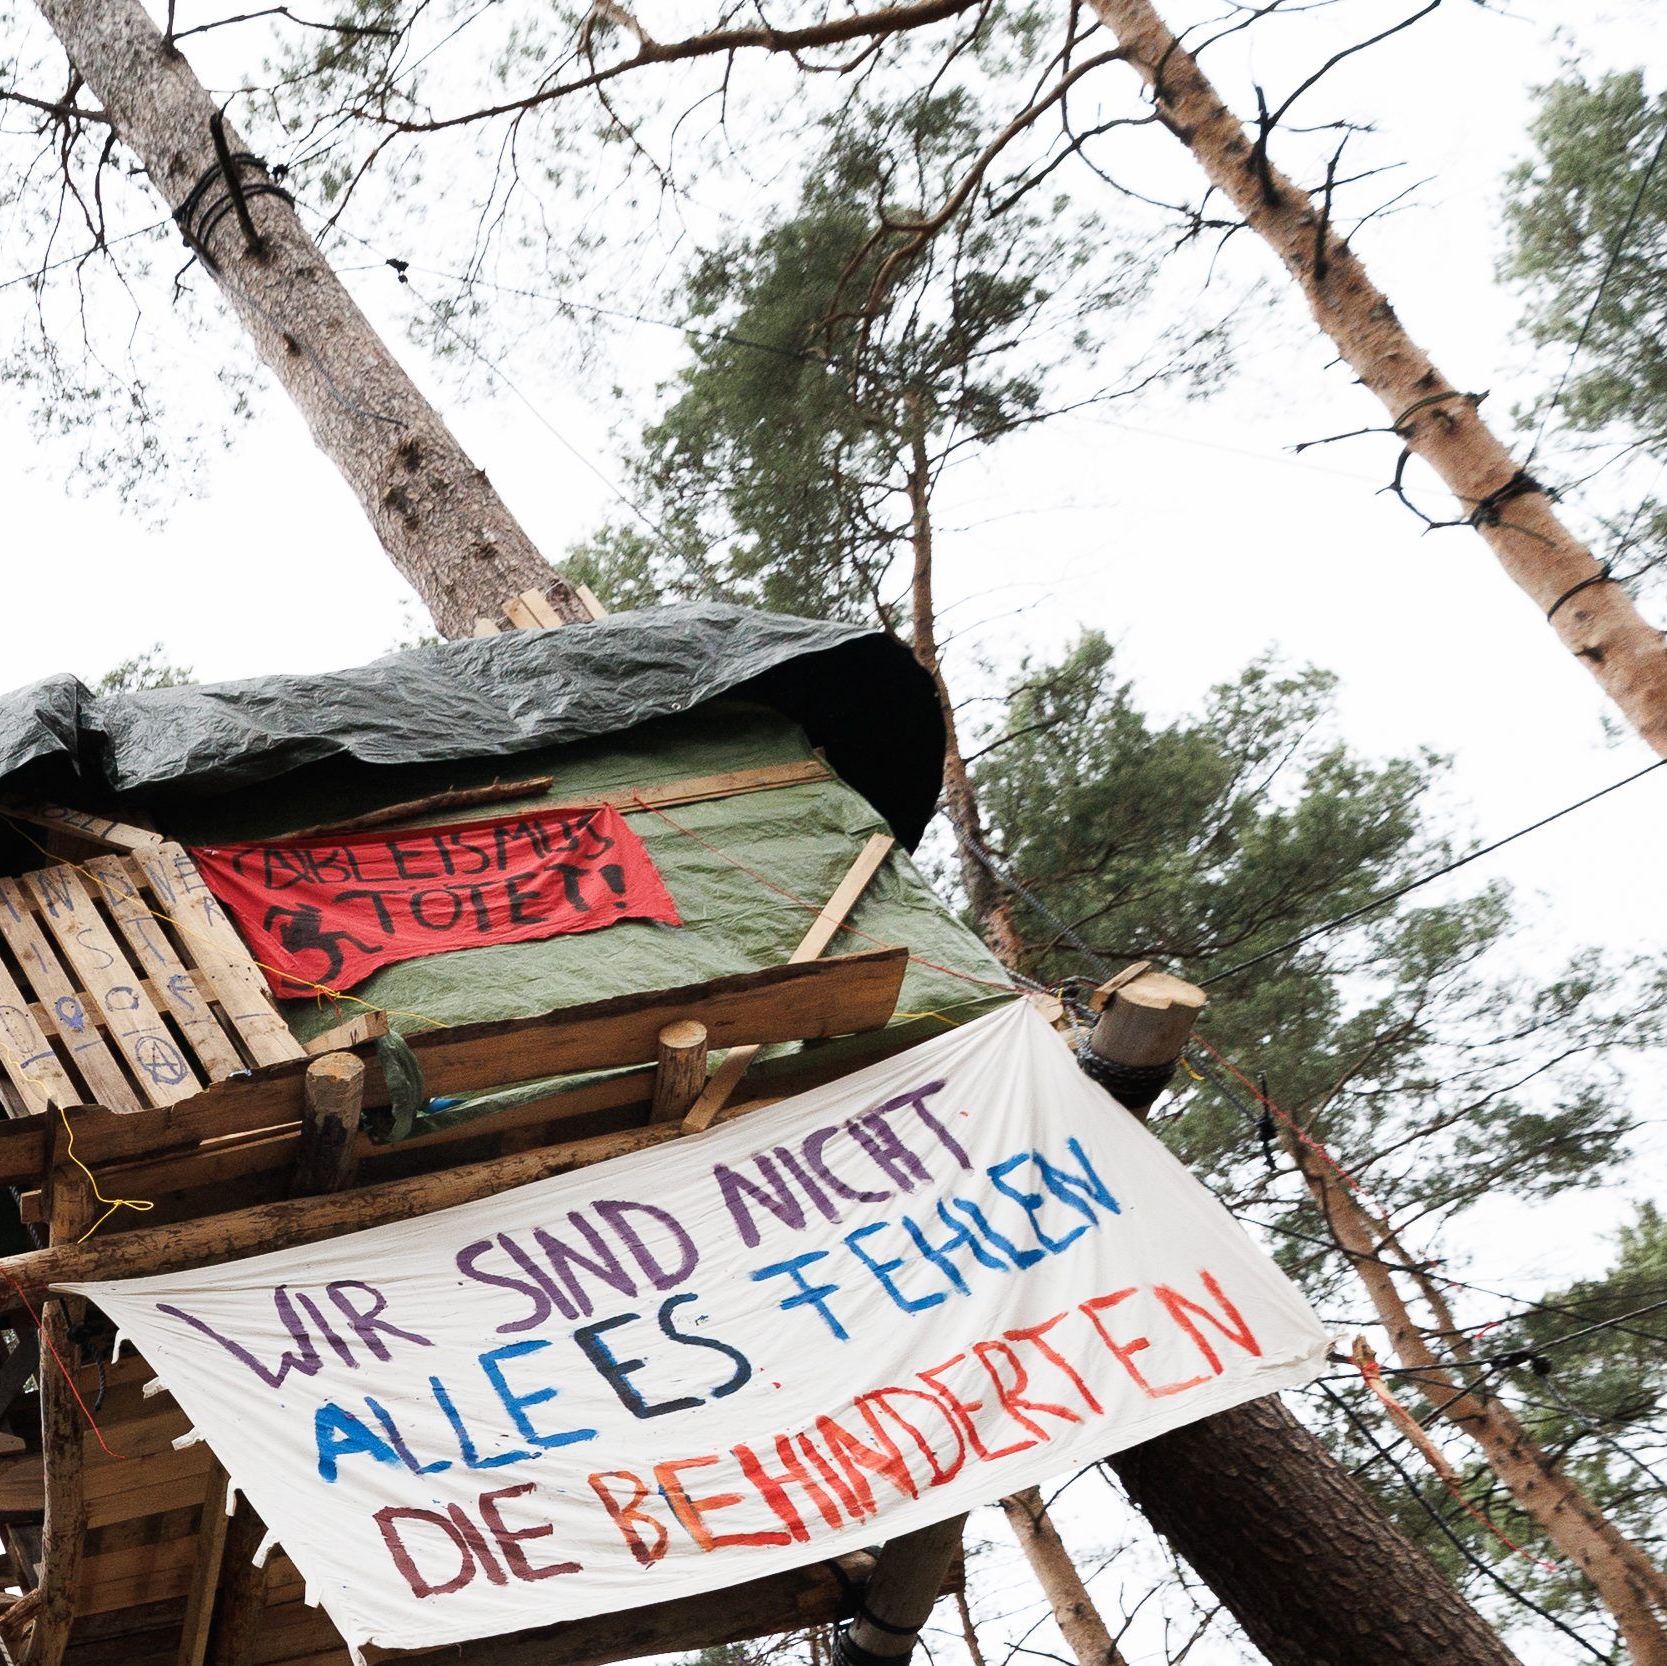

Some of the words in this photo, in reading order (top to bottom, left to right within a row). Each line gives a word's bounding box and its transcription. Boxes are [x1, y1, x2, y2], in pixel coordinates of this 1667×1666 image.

[155, 1279, 435, 1390] WIR
[456, 1199, 699, 1333] SIND
[714, 1079, 976, 1249] NICHT
[315, 1339, 598, 1484] ALLE
[574, 1292, 753, 1420] ES
[750, 1136, 1124, 1342] FEHLEN
[372, 1482, 583, 1600] DIE
[588, 1267, 1264, 1569] BEHINDERTEN
